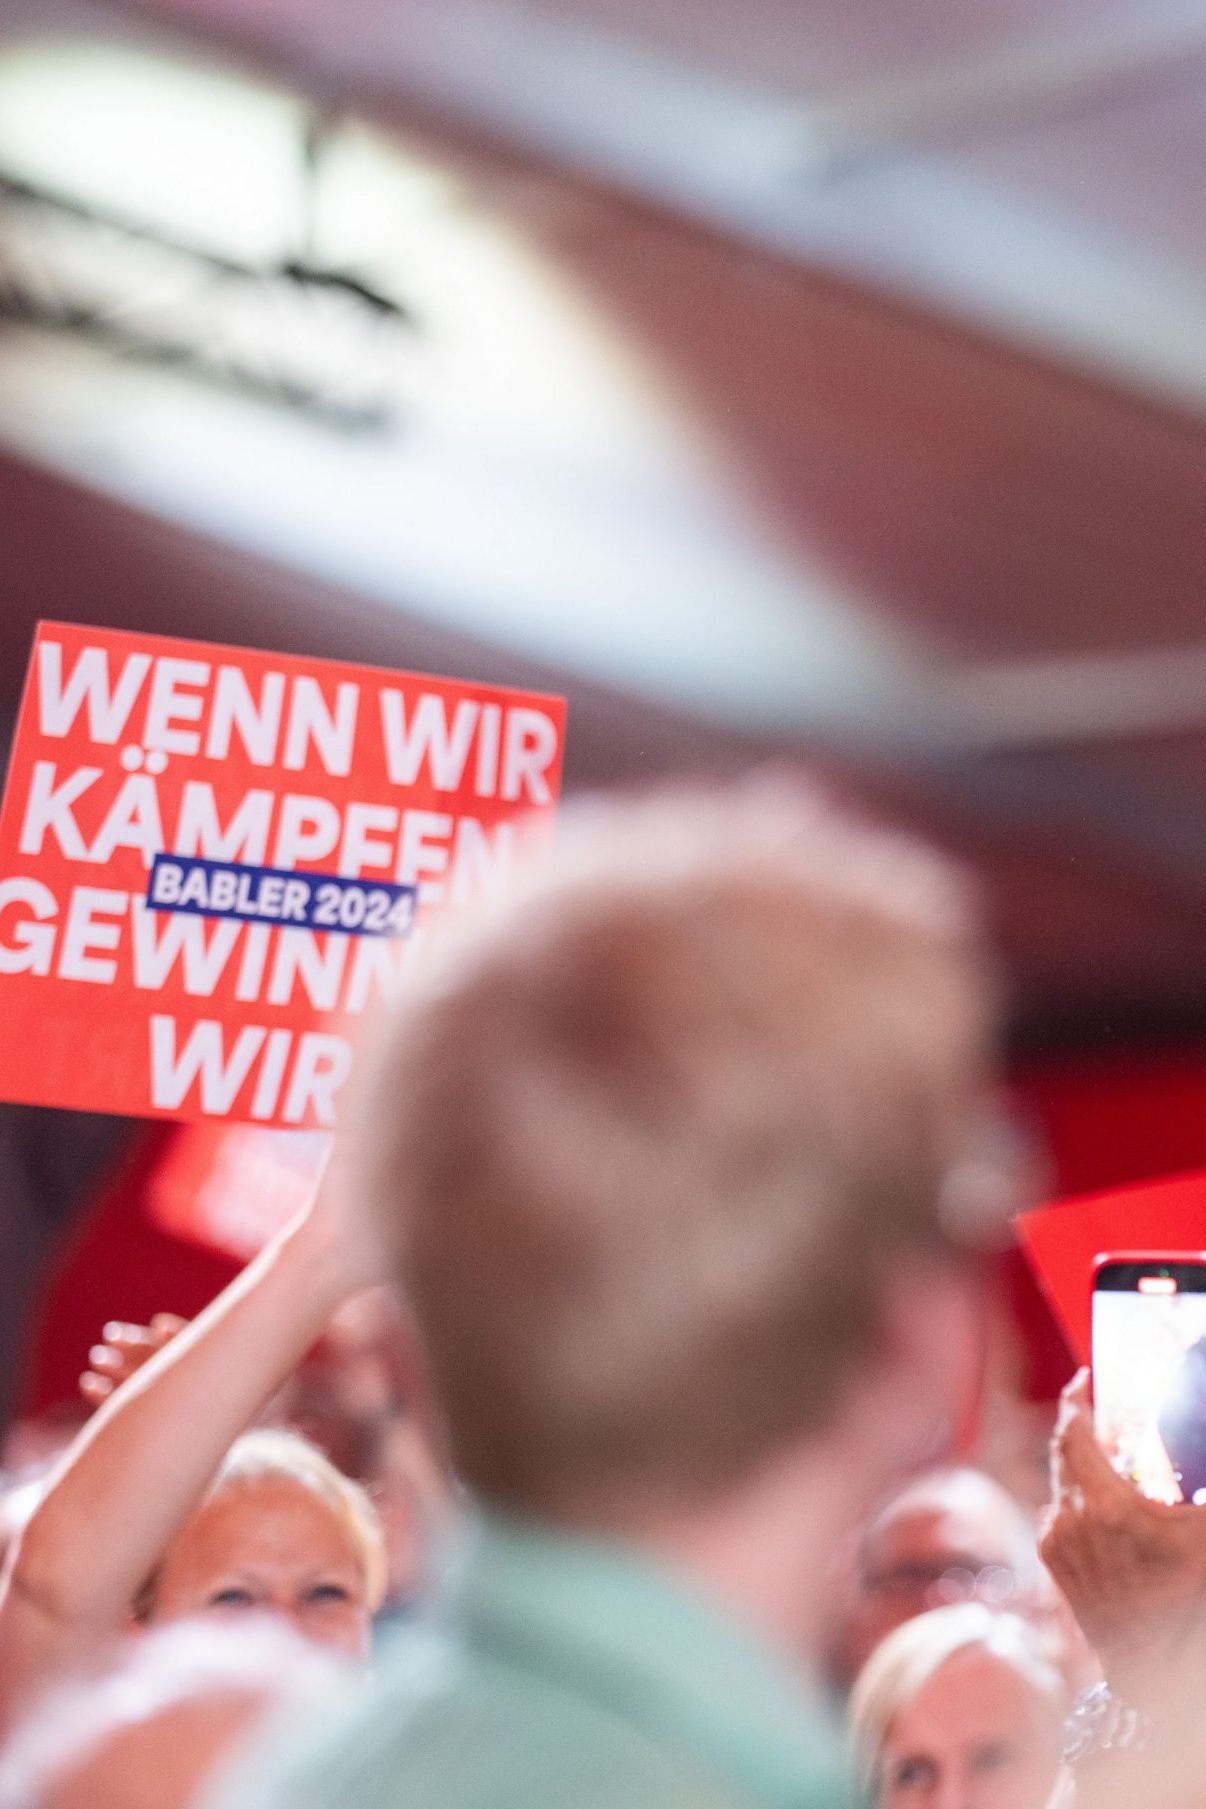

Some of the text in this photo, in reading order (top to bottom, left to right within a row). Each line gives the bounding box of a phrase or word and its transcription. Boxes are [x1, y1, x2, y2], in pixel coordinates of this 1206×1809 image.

[38, 640, 558, 805] WENN WIR
[18, 744, 515, 904] KÄMPFEN
[0, 875, 426, 1014] GEWINN
[153, 861, 415, 933] BABLER 2024
[150, 1013, 353, 1126] WIR
